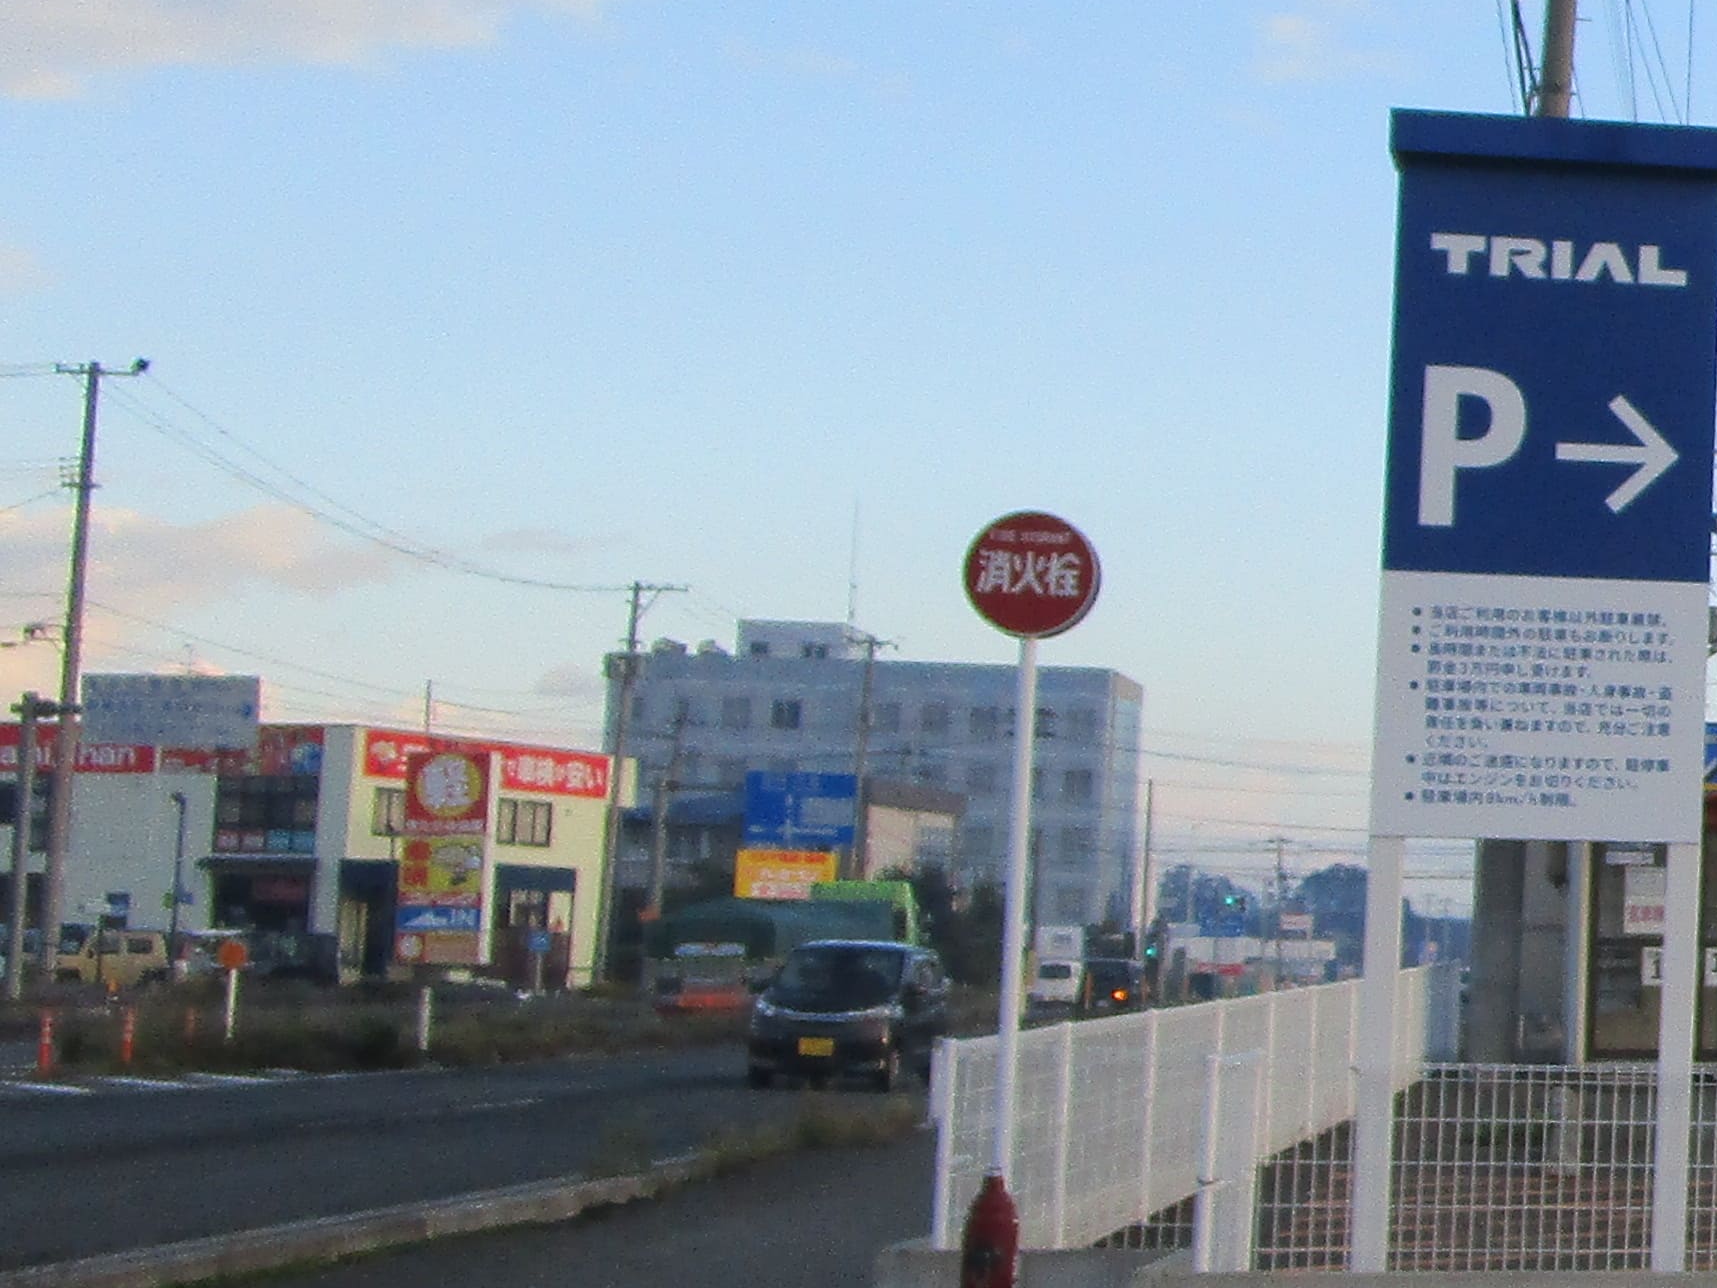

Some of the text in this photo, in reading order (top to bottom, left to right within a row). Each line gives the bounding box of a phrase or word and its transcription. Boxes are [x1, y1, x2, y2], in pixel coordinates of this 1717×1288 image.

[1430, 232, 1688, 287] TRIAL
[1417, 364, 1527, 528] P
[976, 550, 1081, 596] 消火栓
